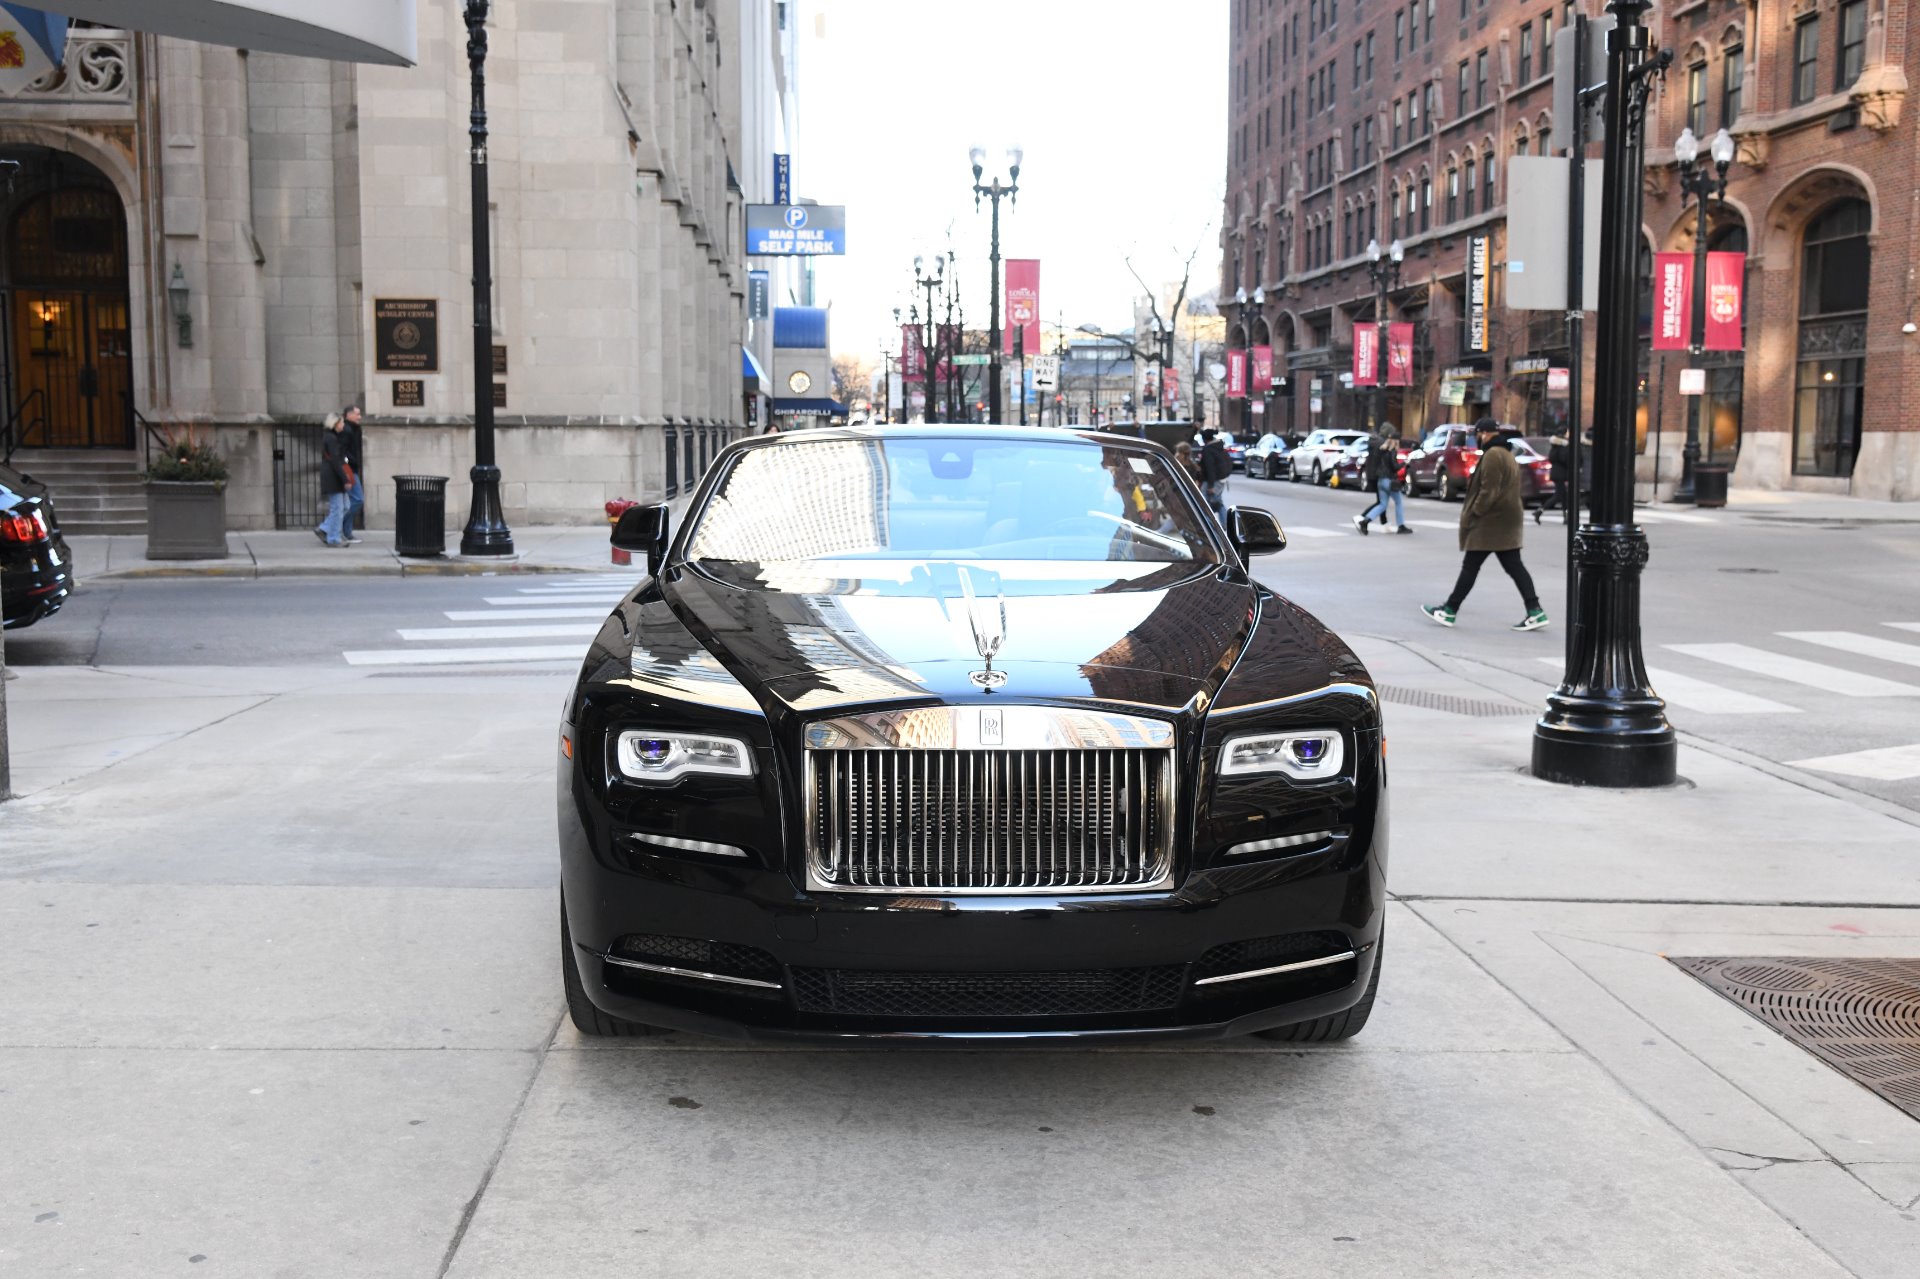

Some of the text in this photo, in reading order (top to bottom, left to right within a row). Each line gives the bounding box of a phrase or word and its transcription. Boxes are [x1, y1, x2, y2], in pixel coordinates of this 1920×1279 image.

[789, 209, 804, 226] P
[768, 229, 824, 240] MAG MILE
[758, 240, 834, 253] SELF PARK
[1473, 237, 1486, 276] BAGELS
[1008, 290, 1036, 298] LOYOLA
[1662, 263, 1676, 338] WELCOME
[1470, 305, 1483, 350] EINSTEIN
[1358, 330, 1367, 378] WELCOME
[1036, 358, 1054, 367] ONE
[1035, 368, 1055, 376] WAY
[398, 382, 418, 393] 835
[774, 408, 831, 416] GHIRARDELLI
